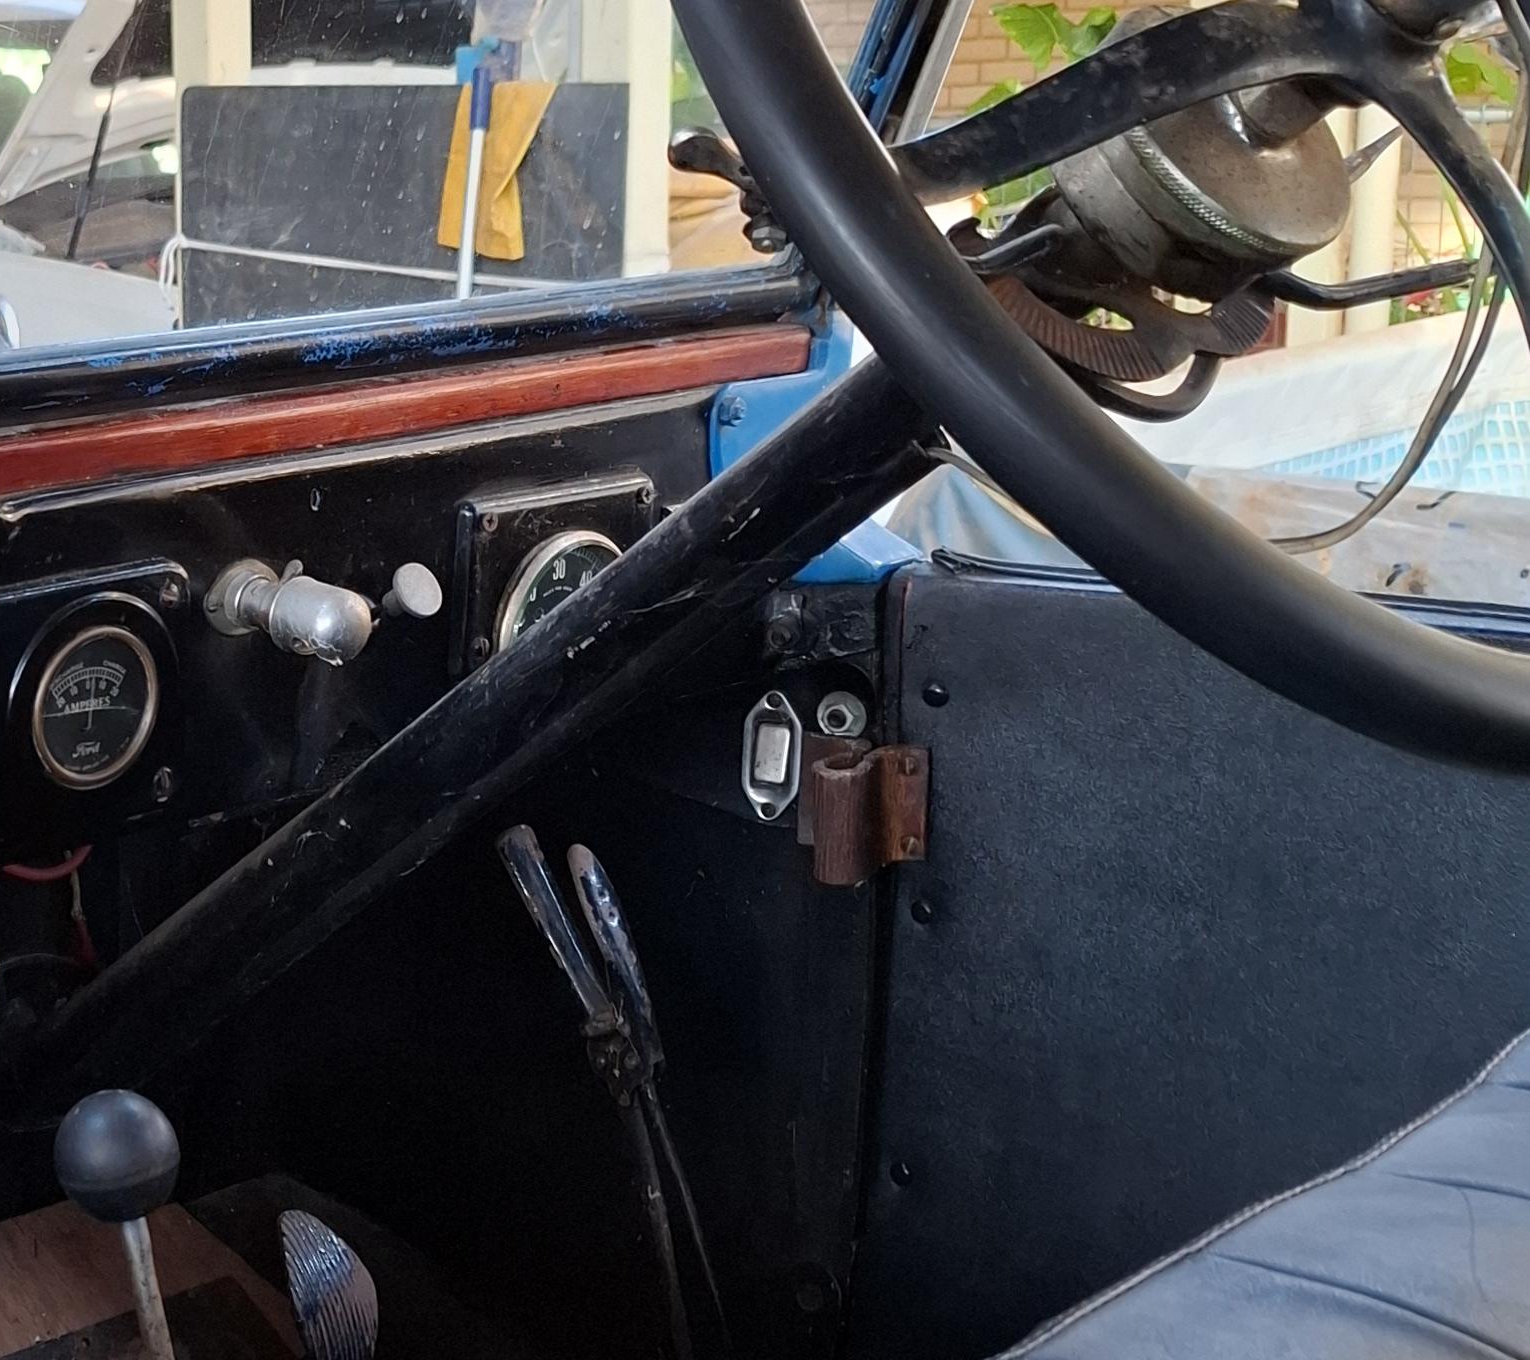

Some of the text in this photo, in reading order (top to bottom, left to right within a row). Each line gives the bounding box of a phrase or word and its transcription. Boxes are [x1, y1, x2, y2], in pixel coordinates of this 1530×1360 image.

[552, 558, 566, 581] 30
[63, 696, 111, 713] AMPERES
[71, 741, 102, 759] Ford
